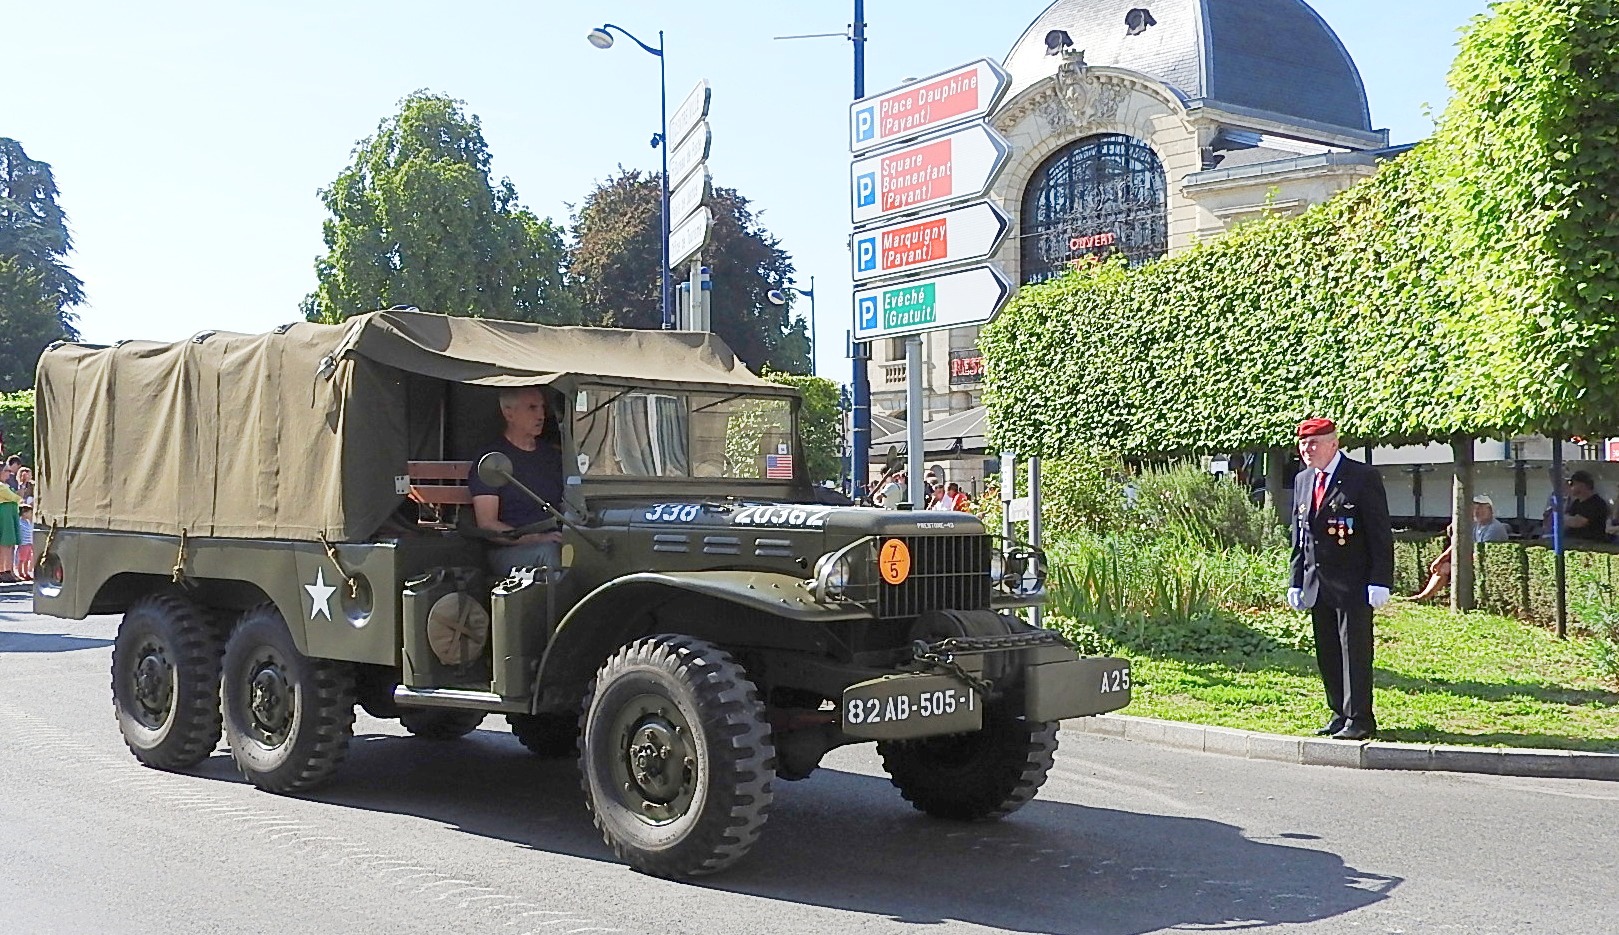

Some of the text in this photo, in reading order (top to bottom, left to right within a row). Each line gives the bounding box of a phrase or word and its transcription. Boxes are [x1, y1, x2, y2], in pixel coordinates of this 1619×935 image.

[881, 74, 977, 118] Place Dauphine
[858, 111, 871, 139] P
[881, 105, 930, 137] (Payant)
[882, 154, 923, 178] Square
[882, 161, 952, 193] Bonnenfant
[859, 177, 873, 205] P
[882, 182, 932, 211] (Payant)
[883, 224, 946, 250] Marquigny
[860, 241, 873, 270] P
[883, 241, 932, 268] (Payant)
[884, 287, 925, 309] Evêché
[862, 300, 874, 328] P
[885, 302, 936, 329] (Gratuit)
[889, 545, 898, 560] 7
[890, 563, 899, 579] 5
[1100, 668, 1130, 694] A25
